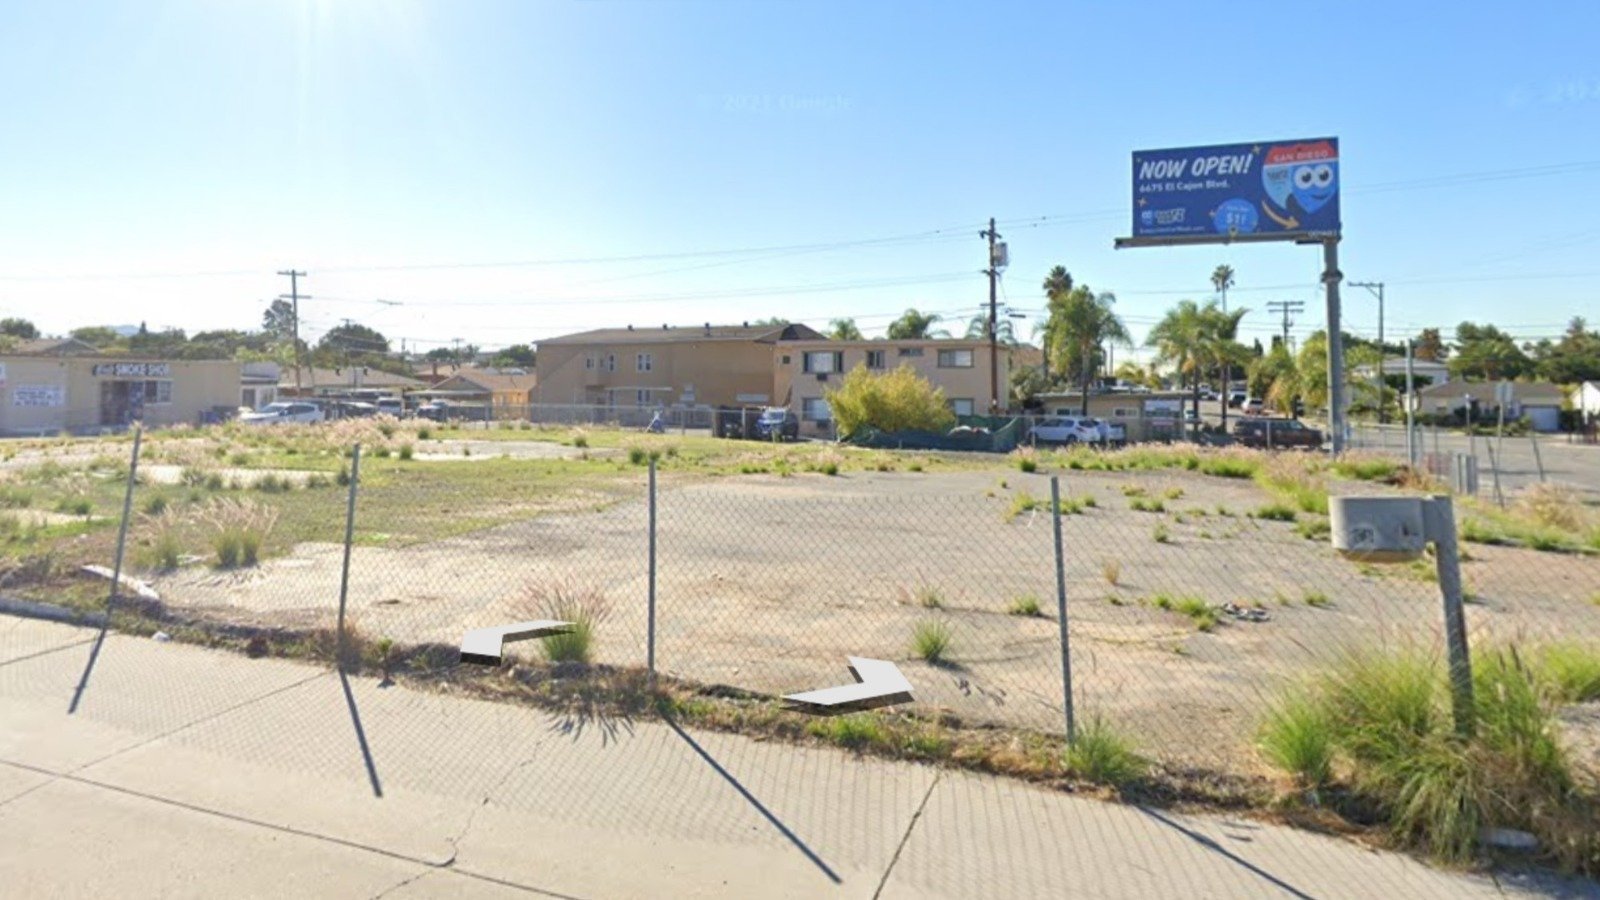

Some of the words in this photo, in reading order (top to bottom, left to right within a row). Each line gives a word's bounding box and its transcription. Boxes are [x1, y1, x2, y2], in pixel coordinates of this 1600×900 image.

[1273, 153, 1293, 162] SAN
[1297, 150, 1328, 160] DIEGO
[1139, 159, 1186, 179] NOW
[1192, 153, 1252, 176] OPEN!
[1177, 181, 1204, 192] Cajon
[115, 363, 145, 376] SMOKE
[148, 363, 170, 376] SHOP
